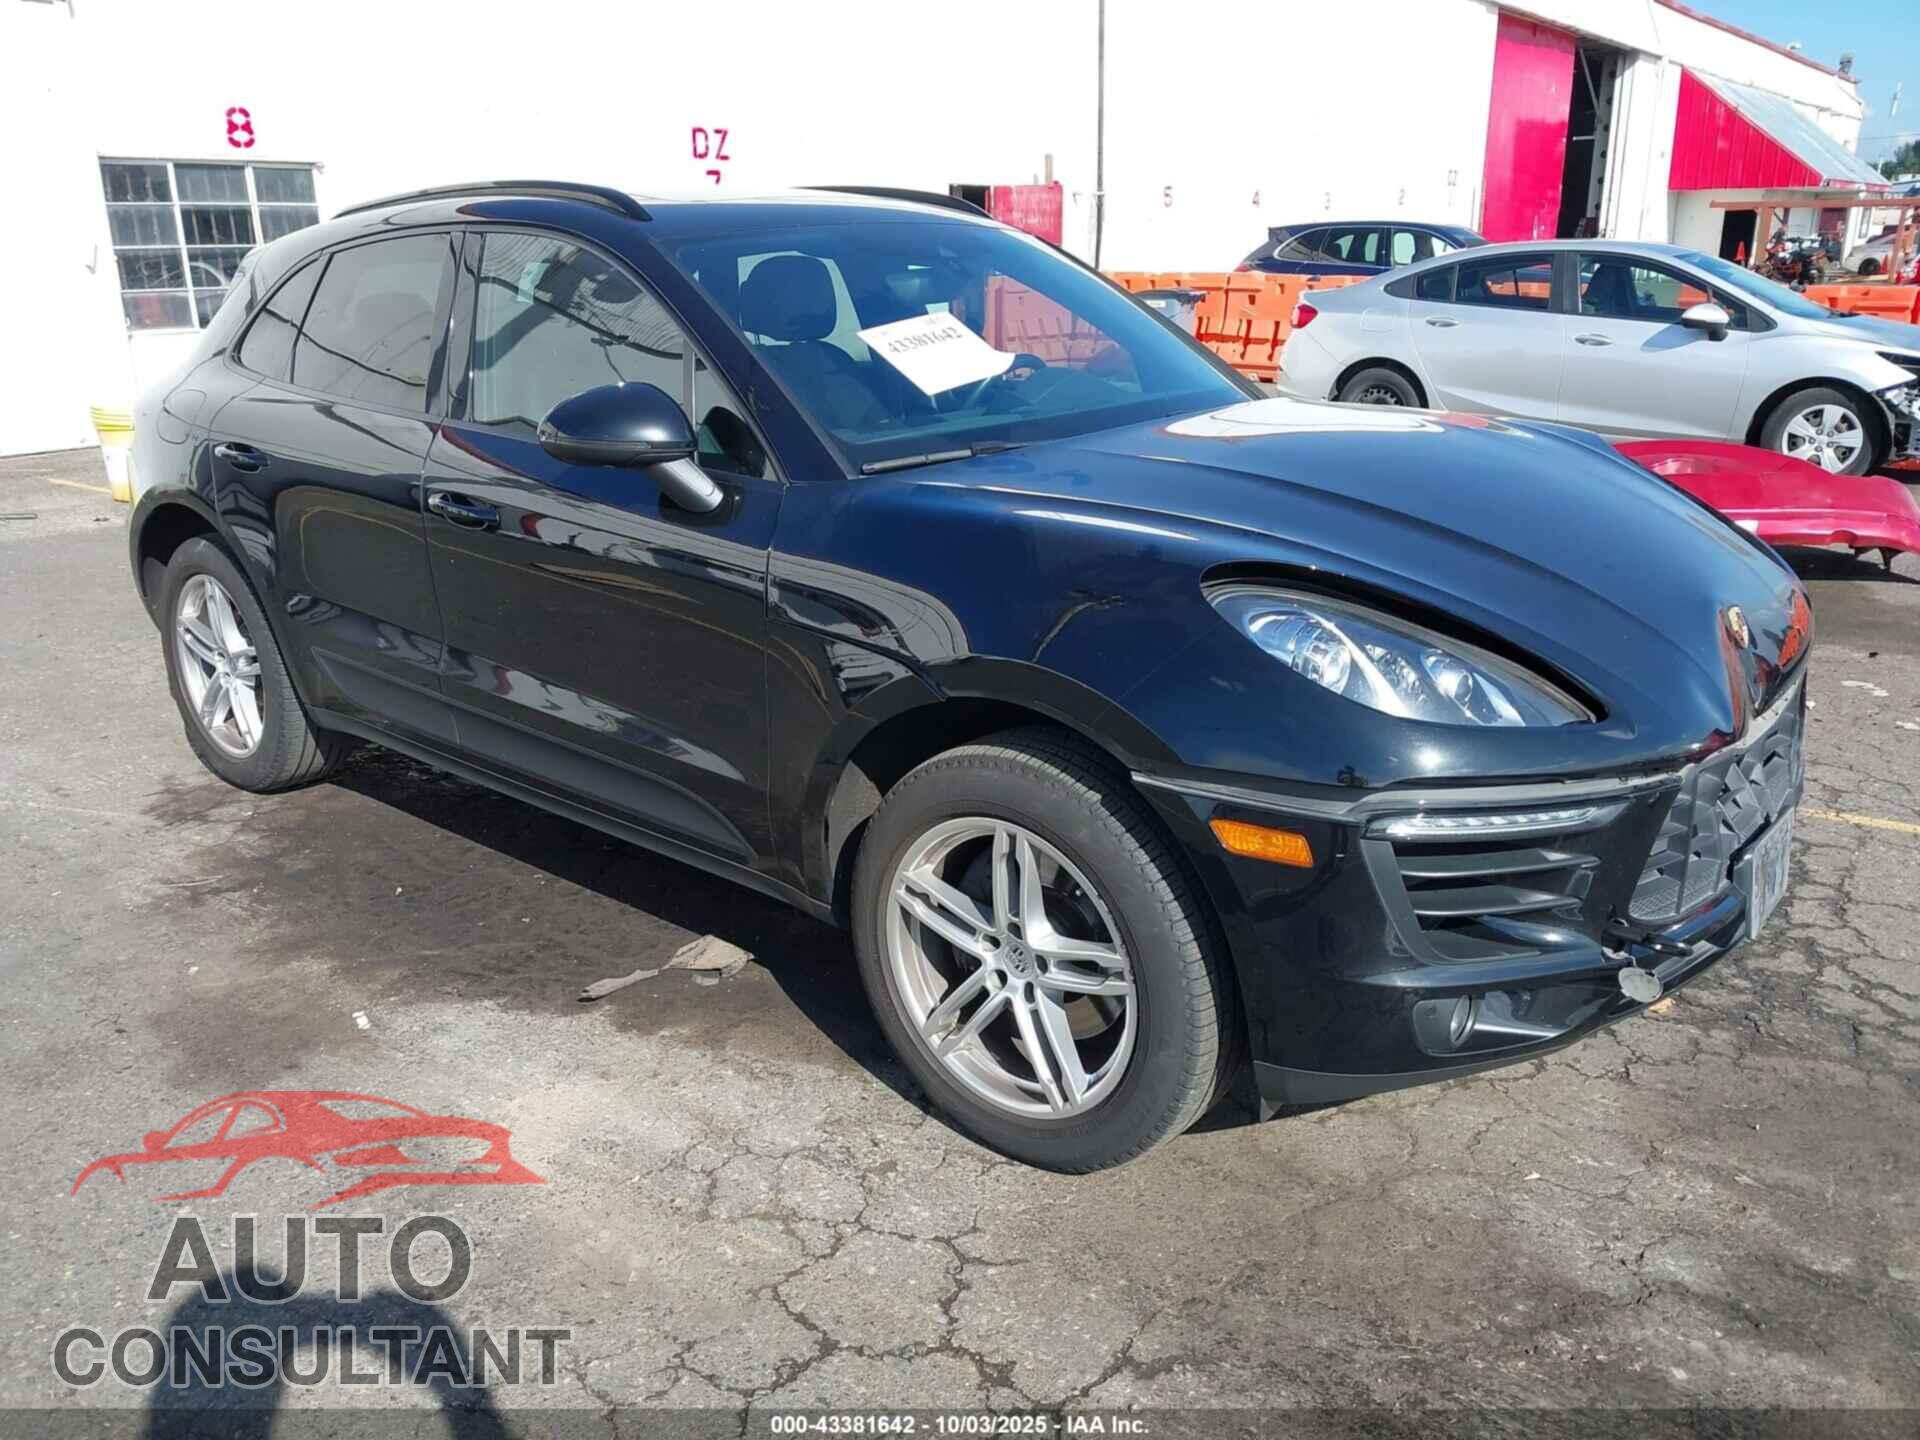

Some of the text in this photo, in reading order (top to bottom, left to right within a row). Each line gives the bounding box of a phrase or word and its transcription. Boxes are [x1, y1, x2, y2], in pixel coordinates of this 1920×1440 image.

[226, 107, 256, 149] 8
[1163, 185, 1174, 208] 5
[1251, 189, 1261, 208] 4
[887, 326, 964, 354] 43381642
